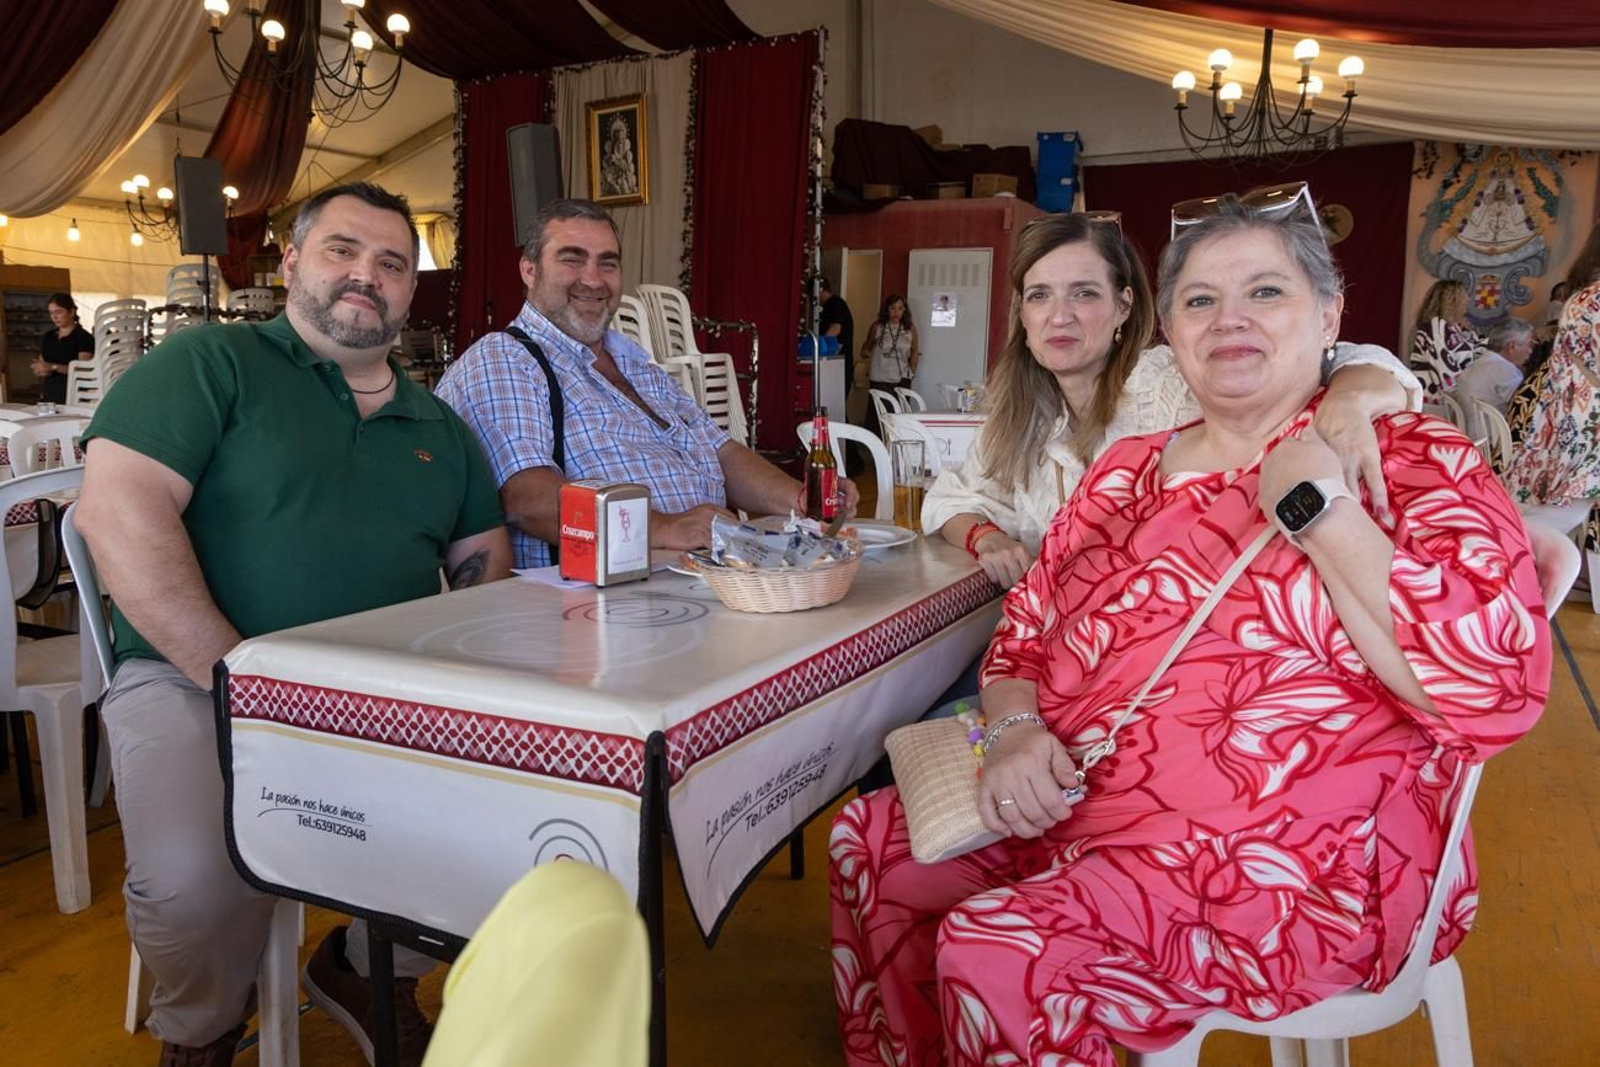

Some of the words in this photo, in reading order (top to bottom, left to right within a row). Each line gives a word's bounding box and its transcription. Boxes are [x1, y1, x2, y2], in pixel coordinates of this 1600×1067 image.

[562, 524, 595, 540] Cruzcampo
[756, 777, 775, 801] nos
[261, 787, 274, 801] La
[275, 793, 301, 808] pasión
[303, 799, 317, 811] nos
[319, 799, 338, 816] hace
[340, 805, 366, 823] únicos
